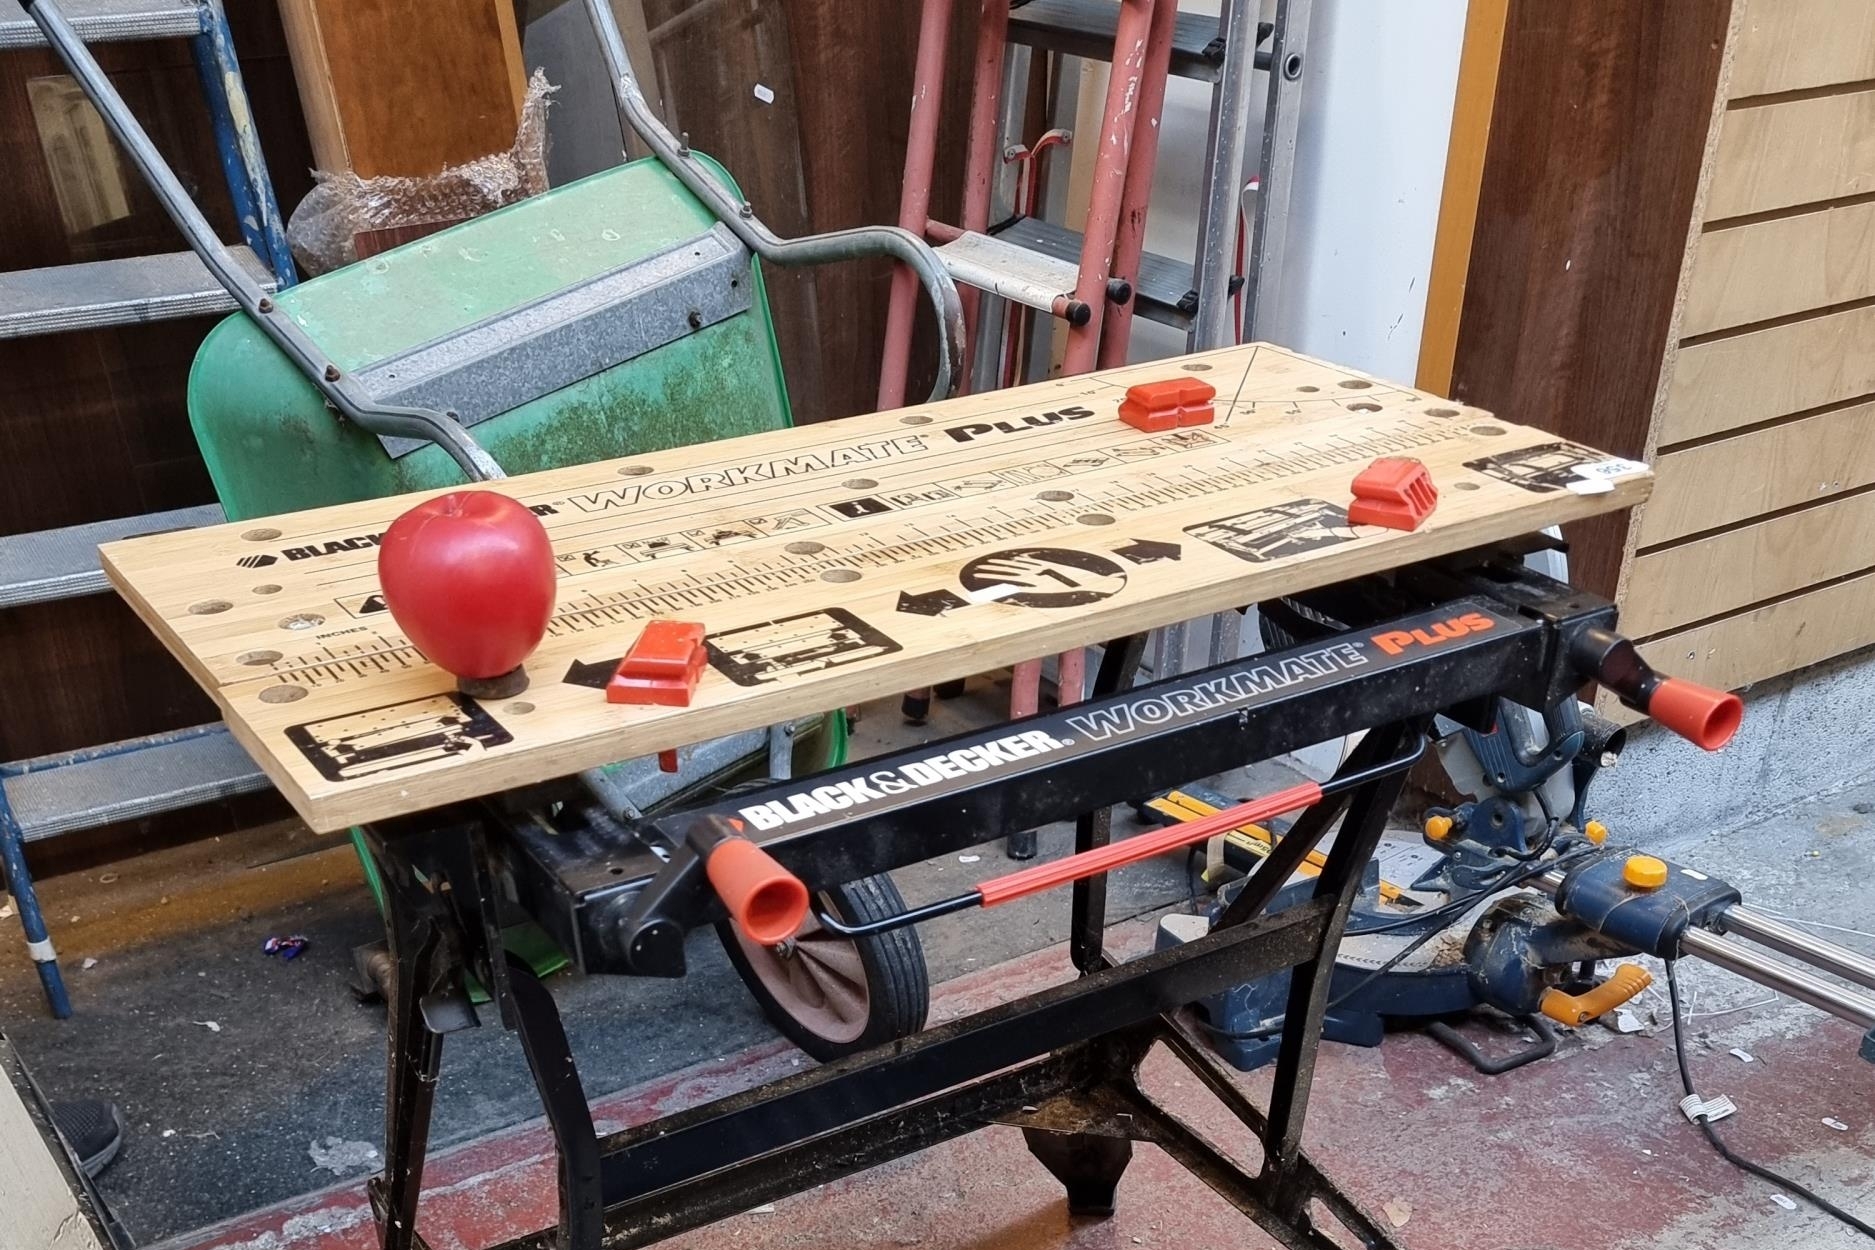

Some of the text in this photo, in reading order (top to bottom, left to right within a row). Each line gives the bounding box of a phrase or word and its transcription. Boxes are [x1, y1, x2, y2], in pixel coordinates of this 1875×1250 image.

[567, 434, 929, 512] WORKMATE
[944, 405, 1096, 443] PLUS
[315, 626, 368, 640] INCHES
[1065, 642, 1369, 742] WORKMATE
[1370, 612, 1496, 656] PLUS
